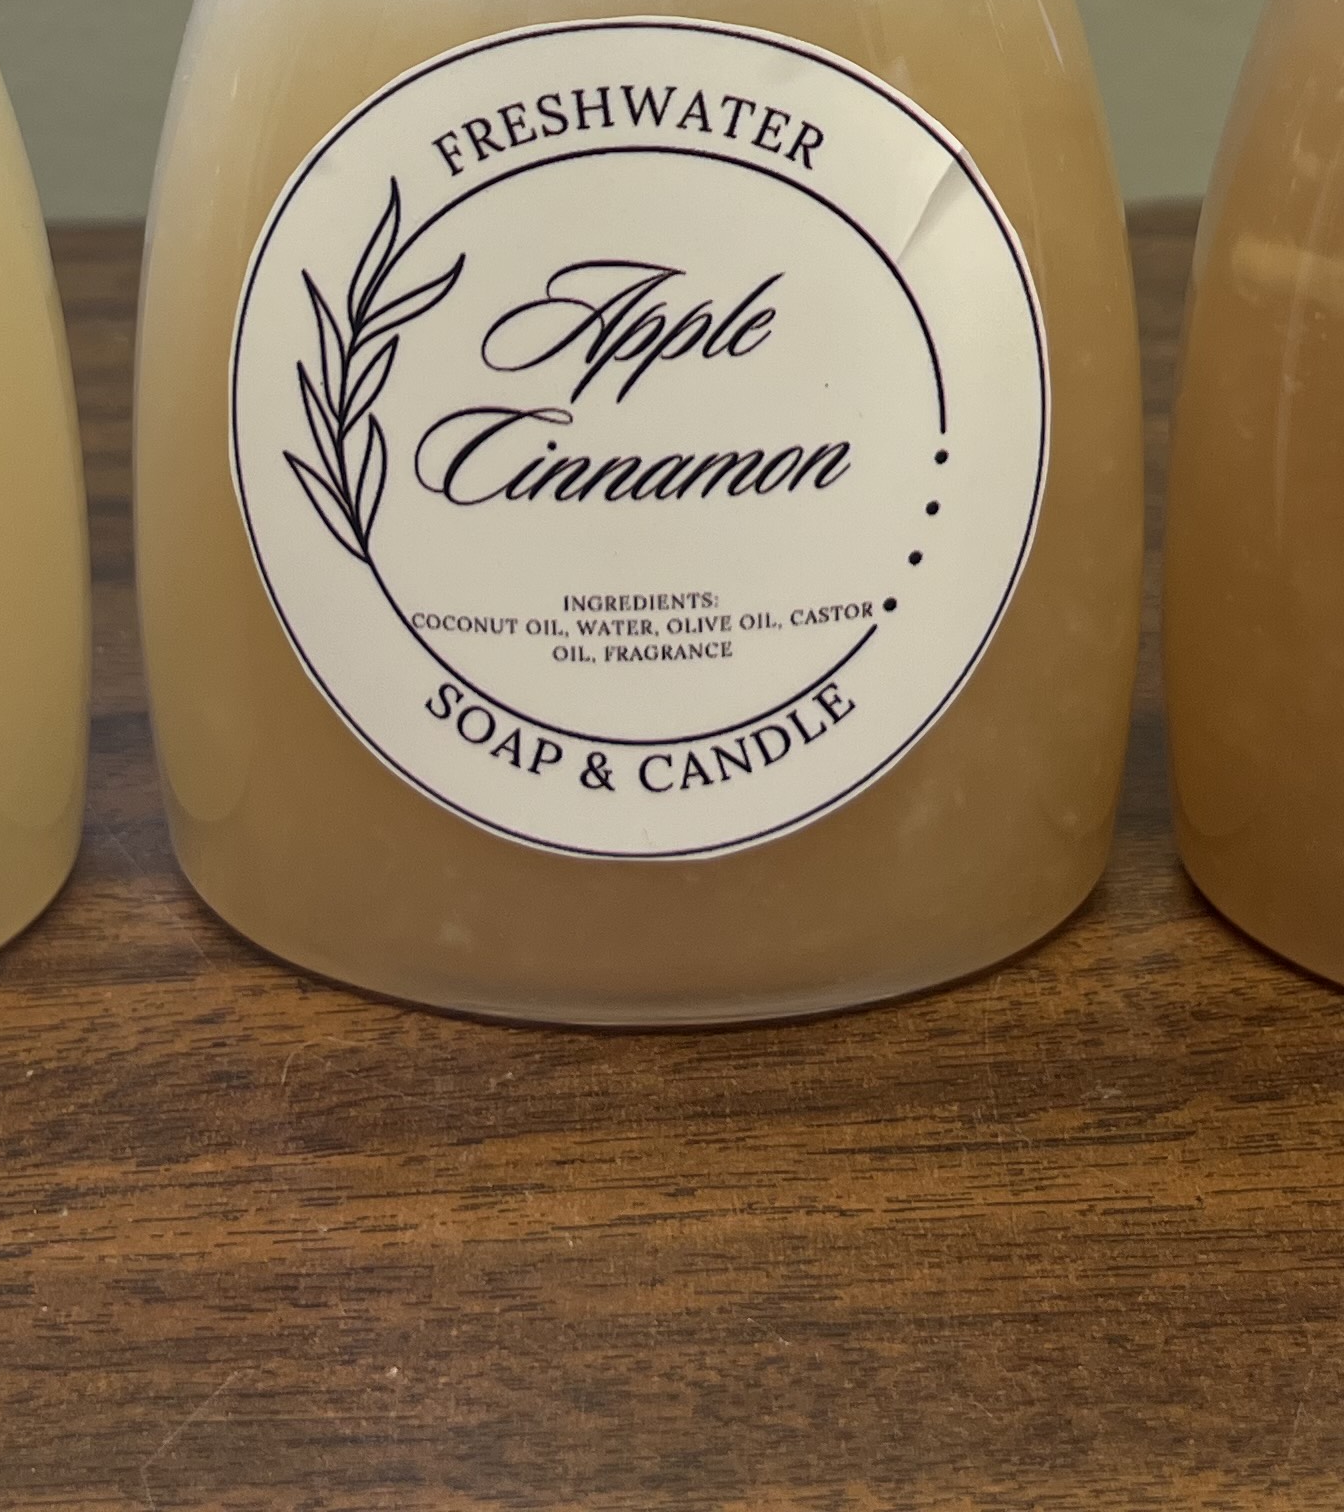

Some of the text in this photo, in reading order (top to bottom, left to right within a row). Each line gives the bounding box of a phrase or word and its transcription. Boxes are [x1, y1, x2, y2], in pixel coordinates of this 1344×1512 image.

[431, 85, 825, 177] FRESHWATER
[480, 259, 786, 404] Apple
[414, 407, 852, 506] Cinnamon
[411, 601, 874, 638] COCONUT OIL, WATER, OLIVE OIL, CASTOR
[562, 592, 720, 612] INGREDIENTS:
[551, 641, 734, 664] OIL, FRAGRANCE
[424, 681, 856, 794] SOAP & CANDLE
